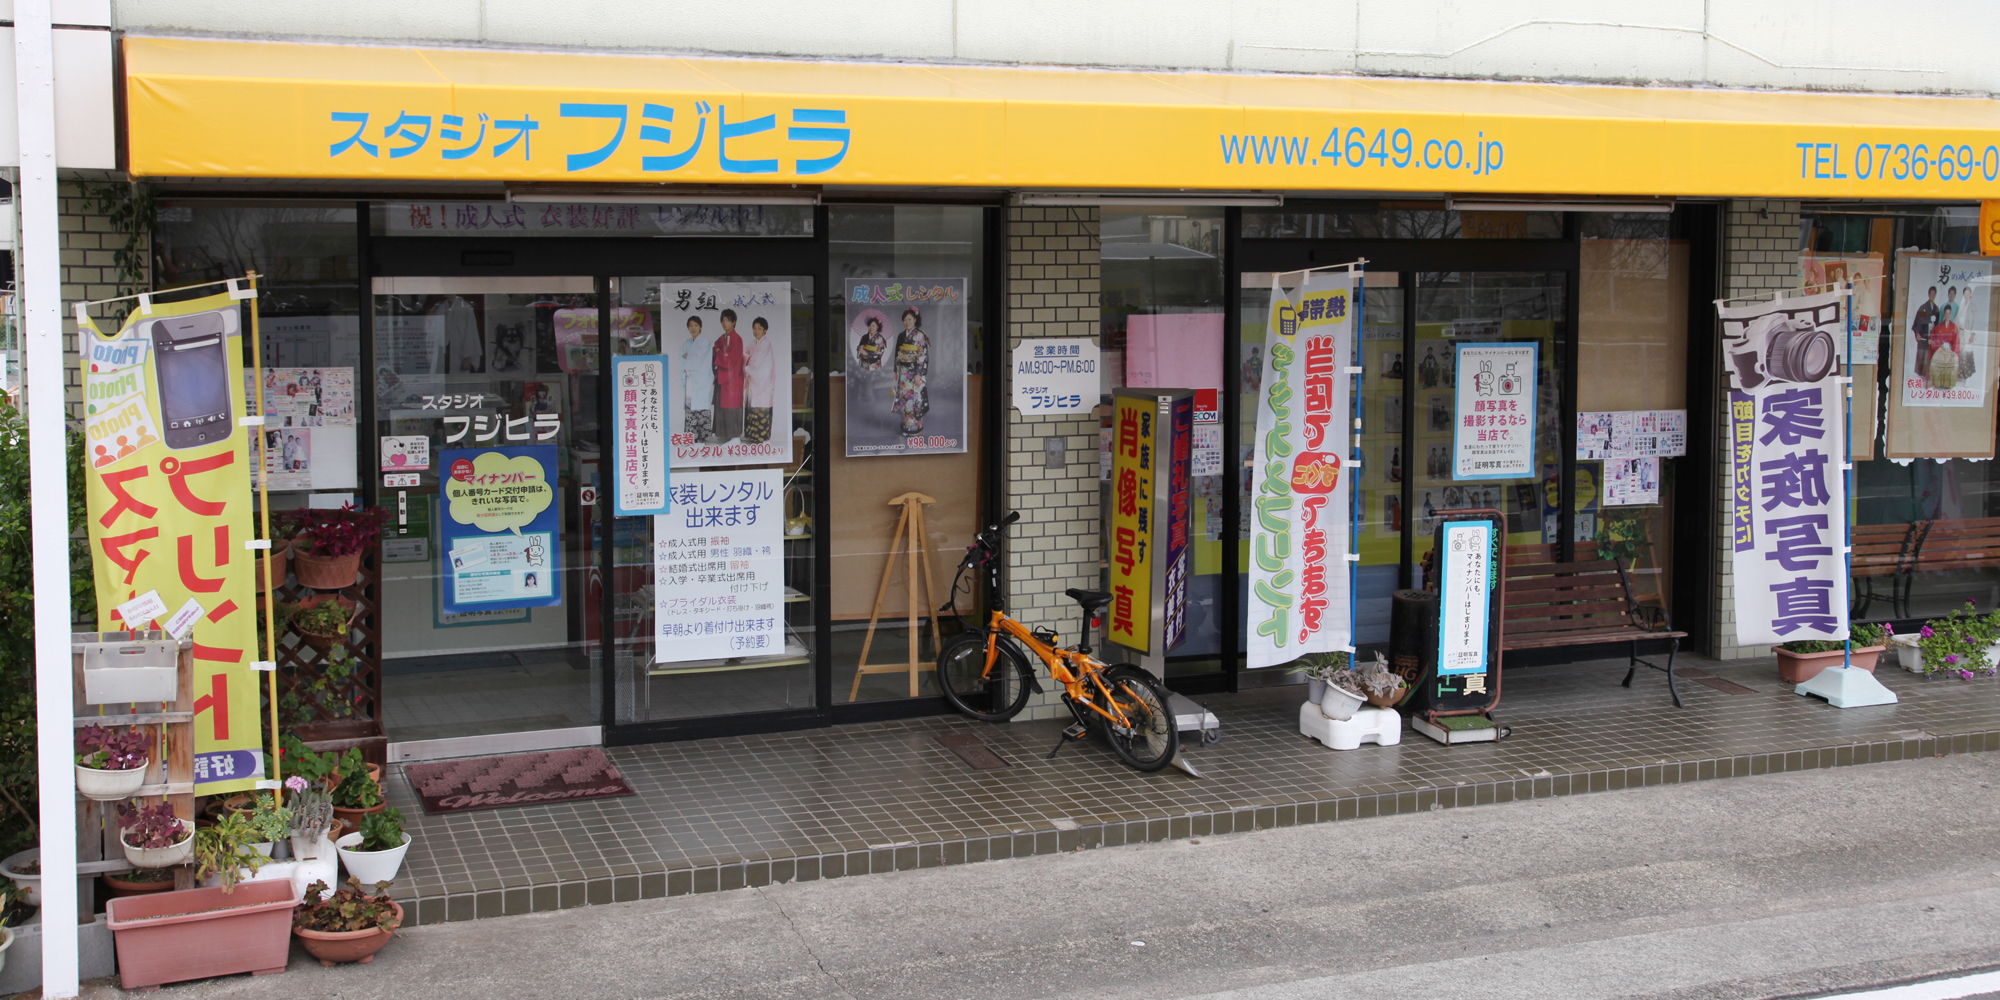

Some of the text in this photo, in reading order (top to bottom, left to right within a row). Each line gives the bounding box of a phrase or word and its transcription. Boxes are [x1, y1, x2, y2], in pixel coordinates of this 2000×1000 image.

[330, 100, 852, 175] スタジオ フジヒラ
[1220, 126, 1504, 176] www.4649.co.jp
[1796, 143, 1847, 179] TEL
[852, 283, 959, 302] 成人式 レンタル
[673, 288, 776, 312] 男組 成人式
[1034, 345, 1080, 356] 営業時間
[1907, 378, 1923, 388] 衣装
[1910, 389, 1940, 399] レンタル
[422, 394, 484, 411] スタジオ
[1031, 395, 1081, 409] フジヒラ
[1474, 400, 1518, 412] 顔写真を
[650, 388, 659, 434] あなたにも、
[1193, 412, 1216, 420] ECOM
[1463, 414, 1527, 427] 撮影するなら
[443, 413, 561, 443] フジヒラ
[1477, 429, 1513, 441] 当店で。
[624, 389, 639, 490] 顔写真は当店で。
[640, 389, 650, 489] マイナンバーはじまります。
[670, 433, 695, 446] 衣装
[676, 445, 723, 459] レンタル
[1474, 461, 1502, 469] 証明写真
[464, 472, 536, 485] マイナンバー
[1169, 404, 1191, 552] ご婚礼写真
[452, 485, 548, 498] 個人番号カード交付申請は、
[669, 481, 774, 506] 衣装レンタル
[1137, 411, 1151, 564] 家族に残す
[471, 495, 530, 505] きれいな写真で。
[636, 491, 660, 499] 証明写真
[686, 504, 761, 528] 出来ます
[1113, 406, 1138, 637] 肖像写真
[668, 536, 730, 548] 成人式用 振袖
[668, 549, 707, 560] 成人式用
[710, 548, 729, 558] 男性
[668, 561, 749, 574] 結婚式出席用 留袖
[1474, 553, 1482, 596] あなたにも、
[668, 572, 755, 586] 入学・卒業式出席用
[730, 582, 769, 593] 付け下げ
[669, 596, 737, 608] ブライダル衣装
[1463, 553, 1473, 649] マイナンバーはじまります。
[662, 617, 775, 637] 早朝より着付け出来ます
[439, 785, 623, 808] Welcome
